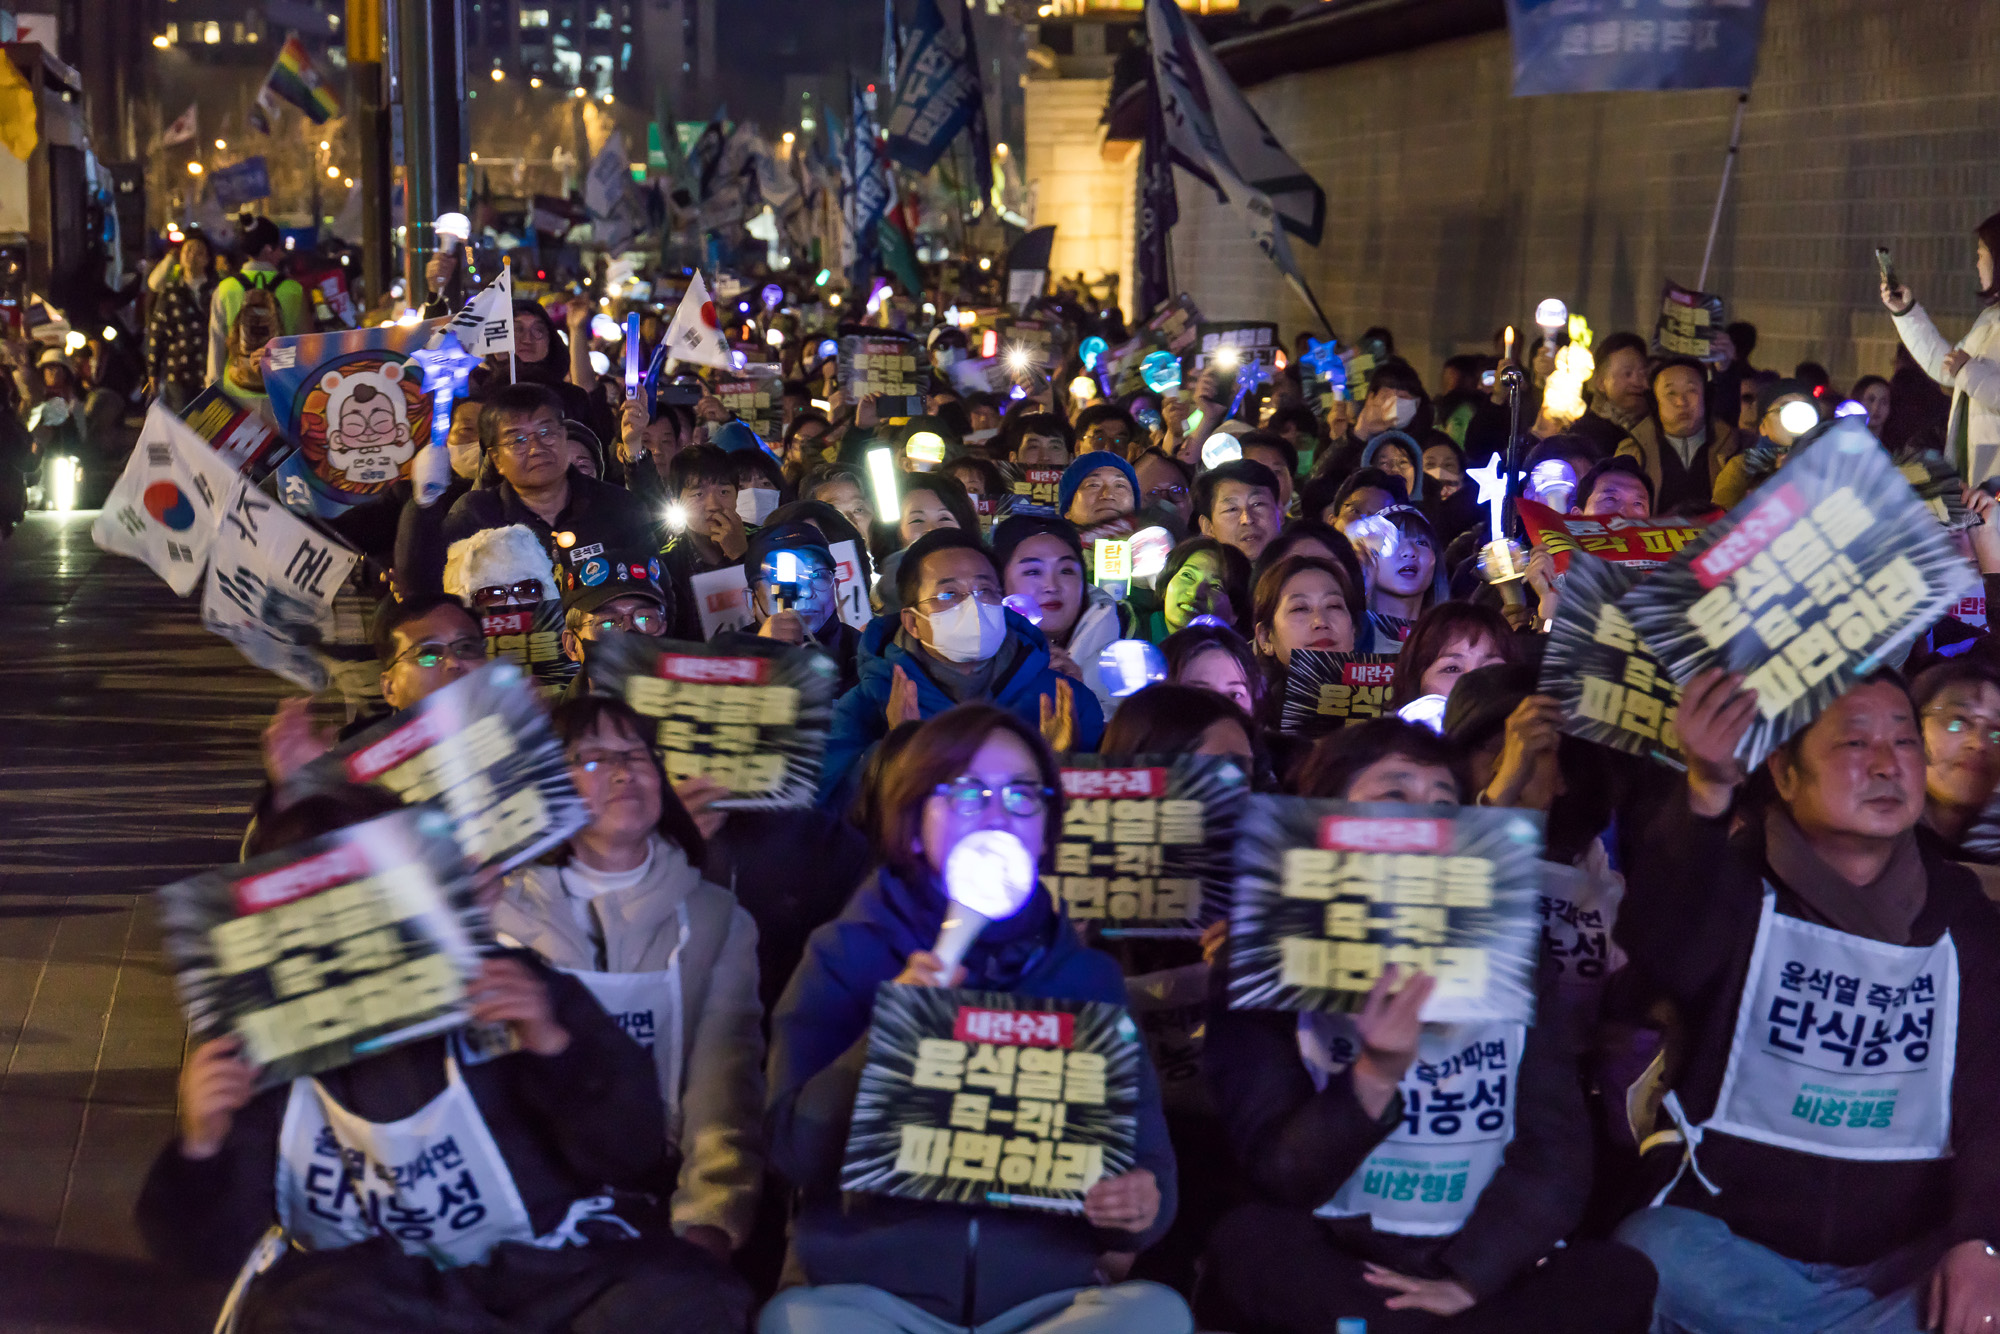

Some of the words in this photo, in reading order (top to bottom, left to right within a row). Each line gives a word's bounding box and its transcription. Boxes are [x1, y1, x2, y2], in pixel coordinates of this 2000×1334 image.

[1686, 486, 1876, 650] 윤석열을
[1740, 556, 1928, 720] 파면하라
[1351, 665, 1394, 683] 내란수
[1780, 960, 1860, 1008] 윤석열
[1768, 996, 1935, 1067] 단식농성
[911, 1038, 1107, 1105] 윤석열을
[1791, 1093, 1896, 1128] 비상행동
[894, 1124, 1104, 1193] 파면하라
[1363, 1169, 1468, 1204] 비상행동
